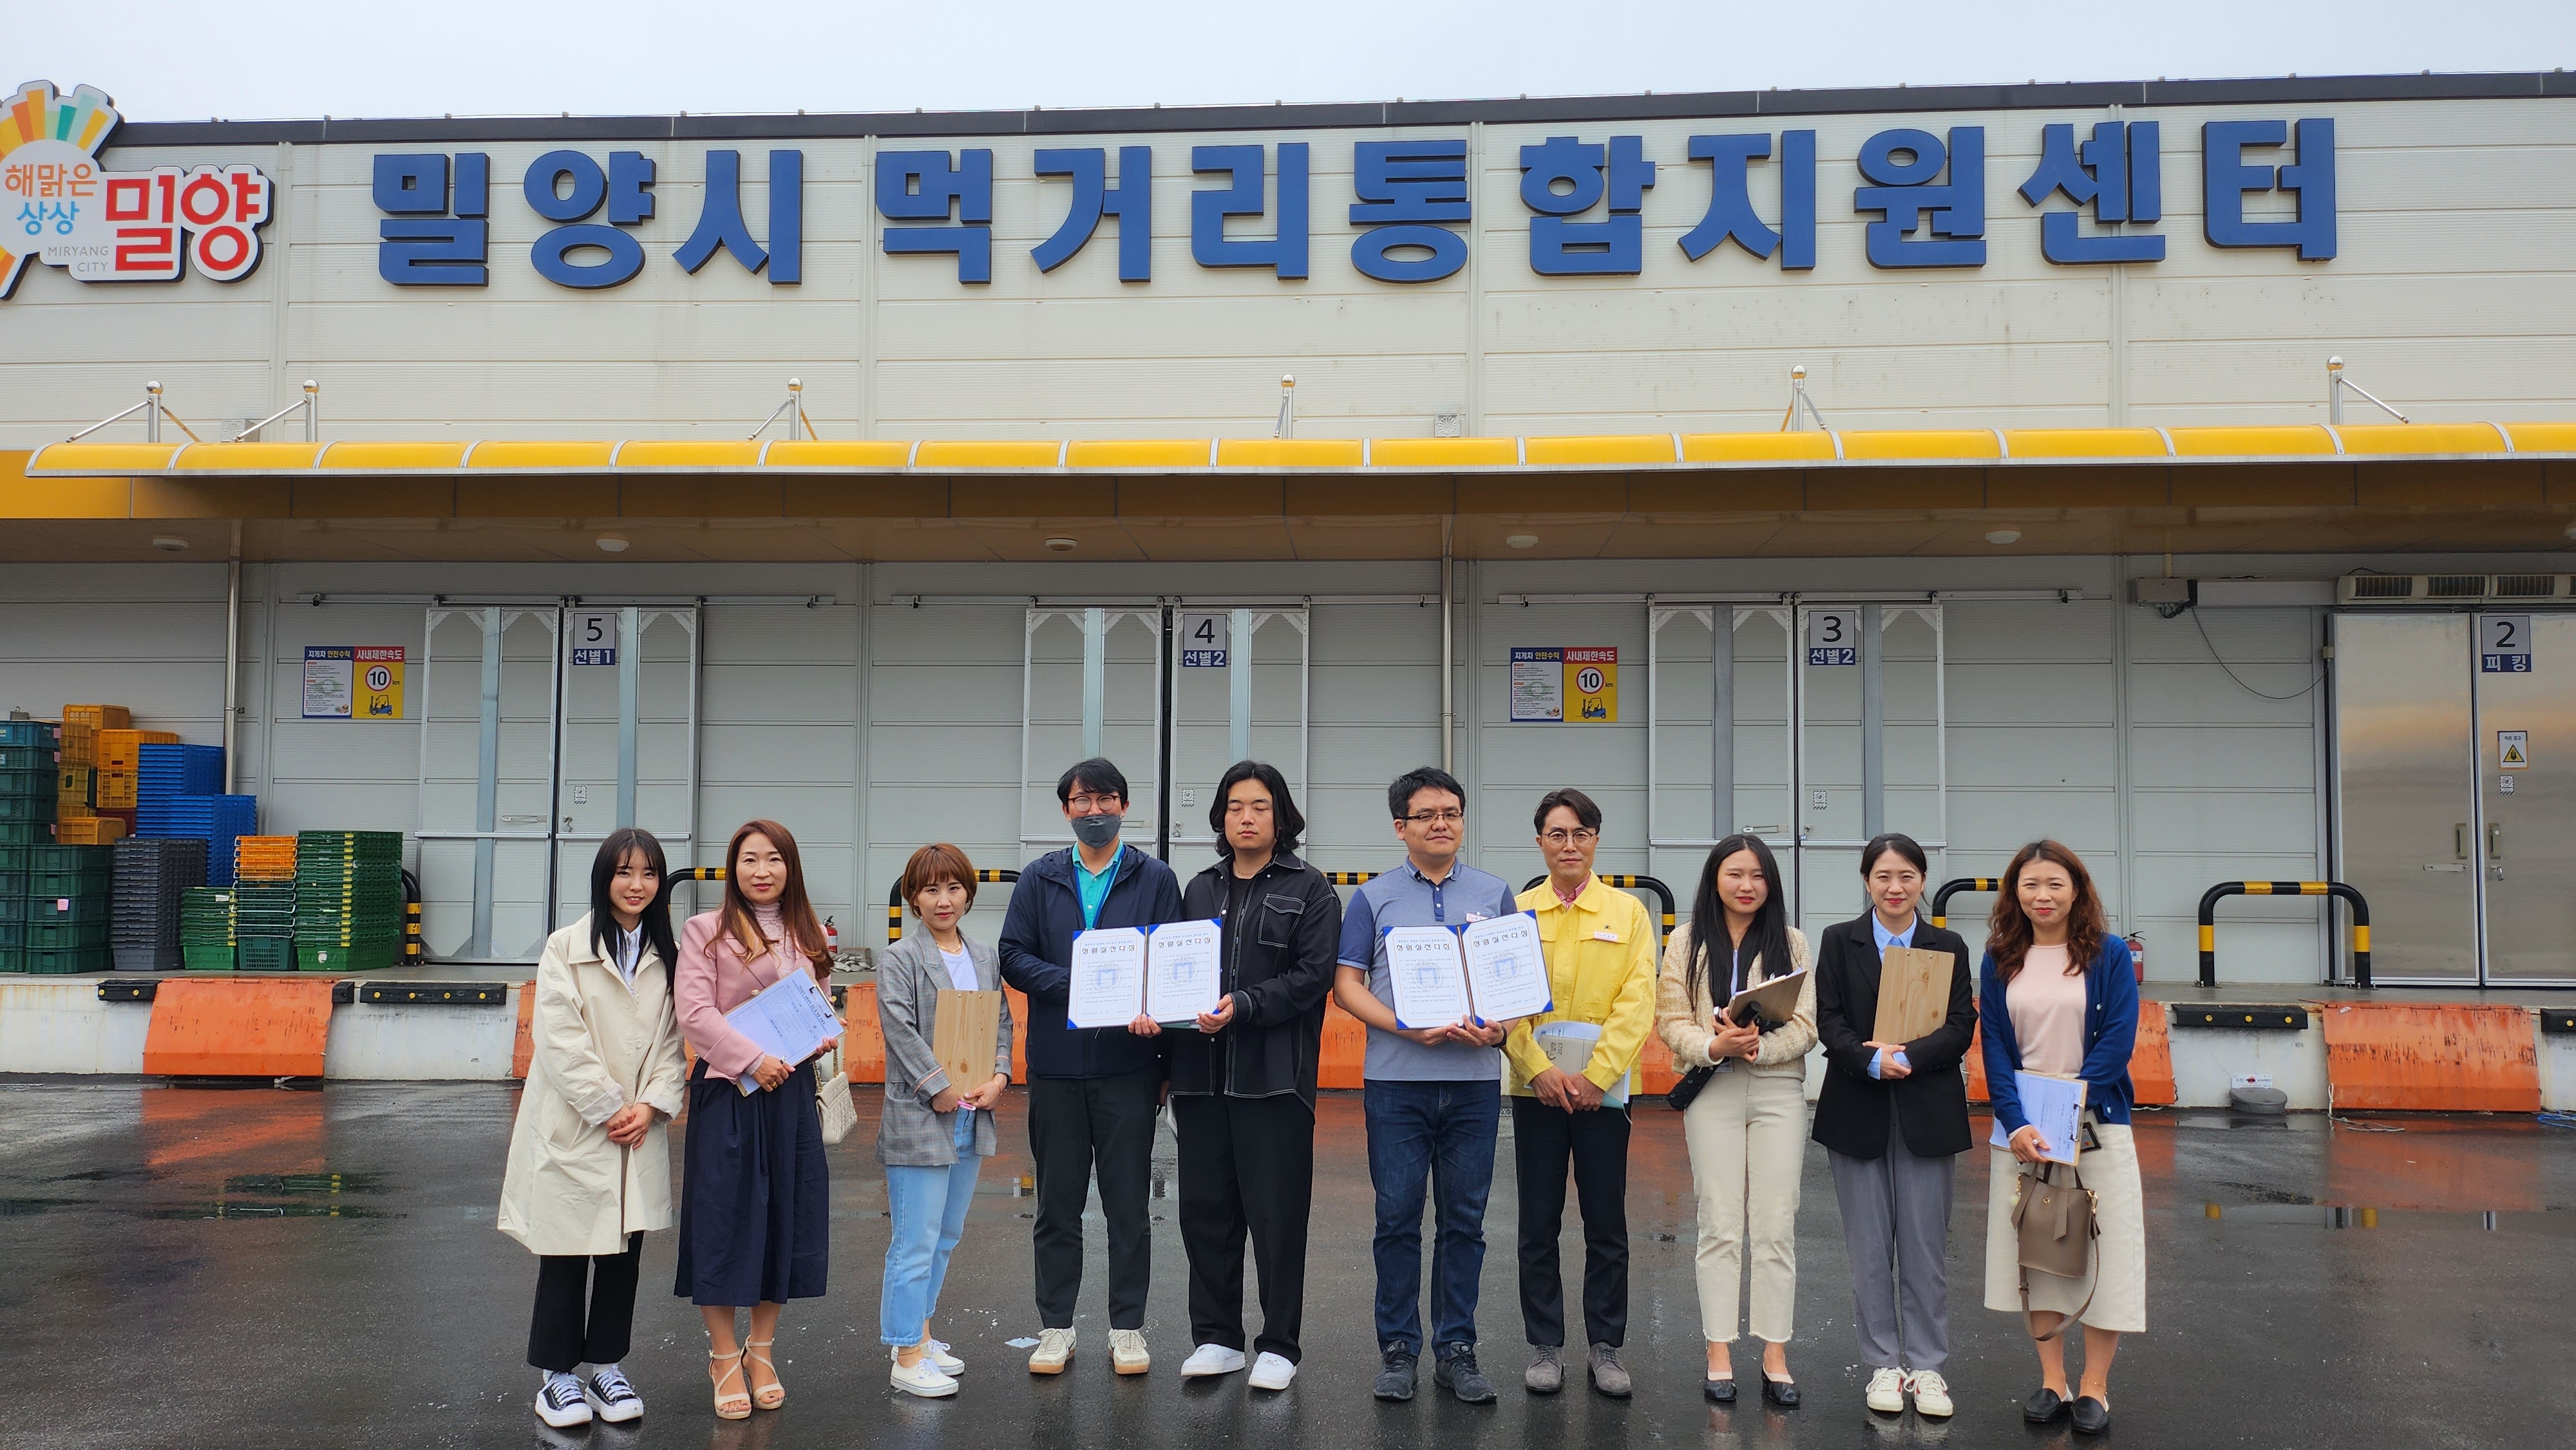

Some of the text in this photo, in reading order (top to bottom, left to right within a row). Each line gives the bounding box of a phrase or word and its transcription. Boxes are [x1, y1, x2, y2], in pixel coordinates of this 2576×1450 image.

[5, 162, 98, 198] 해맑은
[373, 117, 2336, 289] 밀양시 먹거리통합지원센터
[17, 200, 80, 236] 상상
[105, 173, 261, 272] 밀양
[48, 245, 109, 257] MIRYANG
[77, 261, 109, 272] CITY
[587, 617, 603, 642] 5
[1195, 619, 1215, 644] 4
[1822, 616, 1842, 643] 3
[2496, 621, 2516, 648] 2
[356, 649, 402, 660] 사내제한속도
[1514, 651, 1560, 660] 지게차 안전수칙
[1566, 650, 1615, 662] 사내제한속도
[369, 671, 387, 686] 10
[1580, 673, 1600, 688] 10
